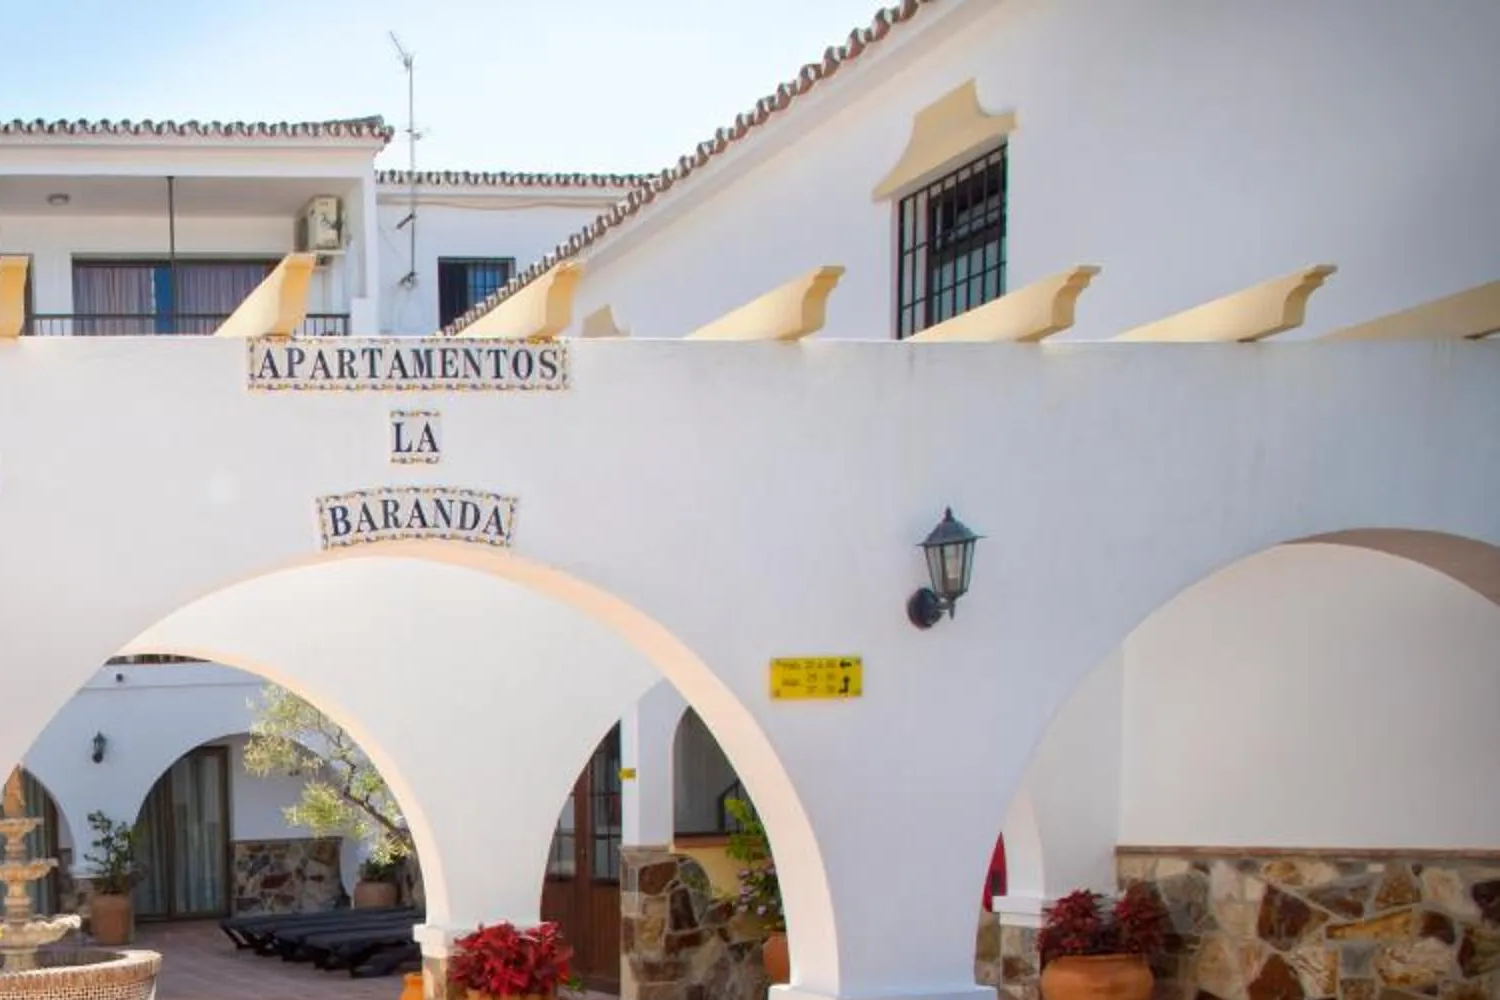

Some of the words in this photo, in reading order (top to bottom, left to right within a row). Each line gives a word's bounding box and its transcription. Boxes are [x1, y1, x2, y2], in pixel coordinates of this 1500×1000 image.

[256, 347, 559, 380] APARTAMENTOS
[392, 421, 440, 453] LA
[329, 498, 505, 537] BARANDA
